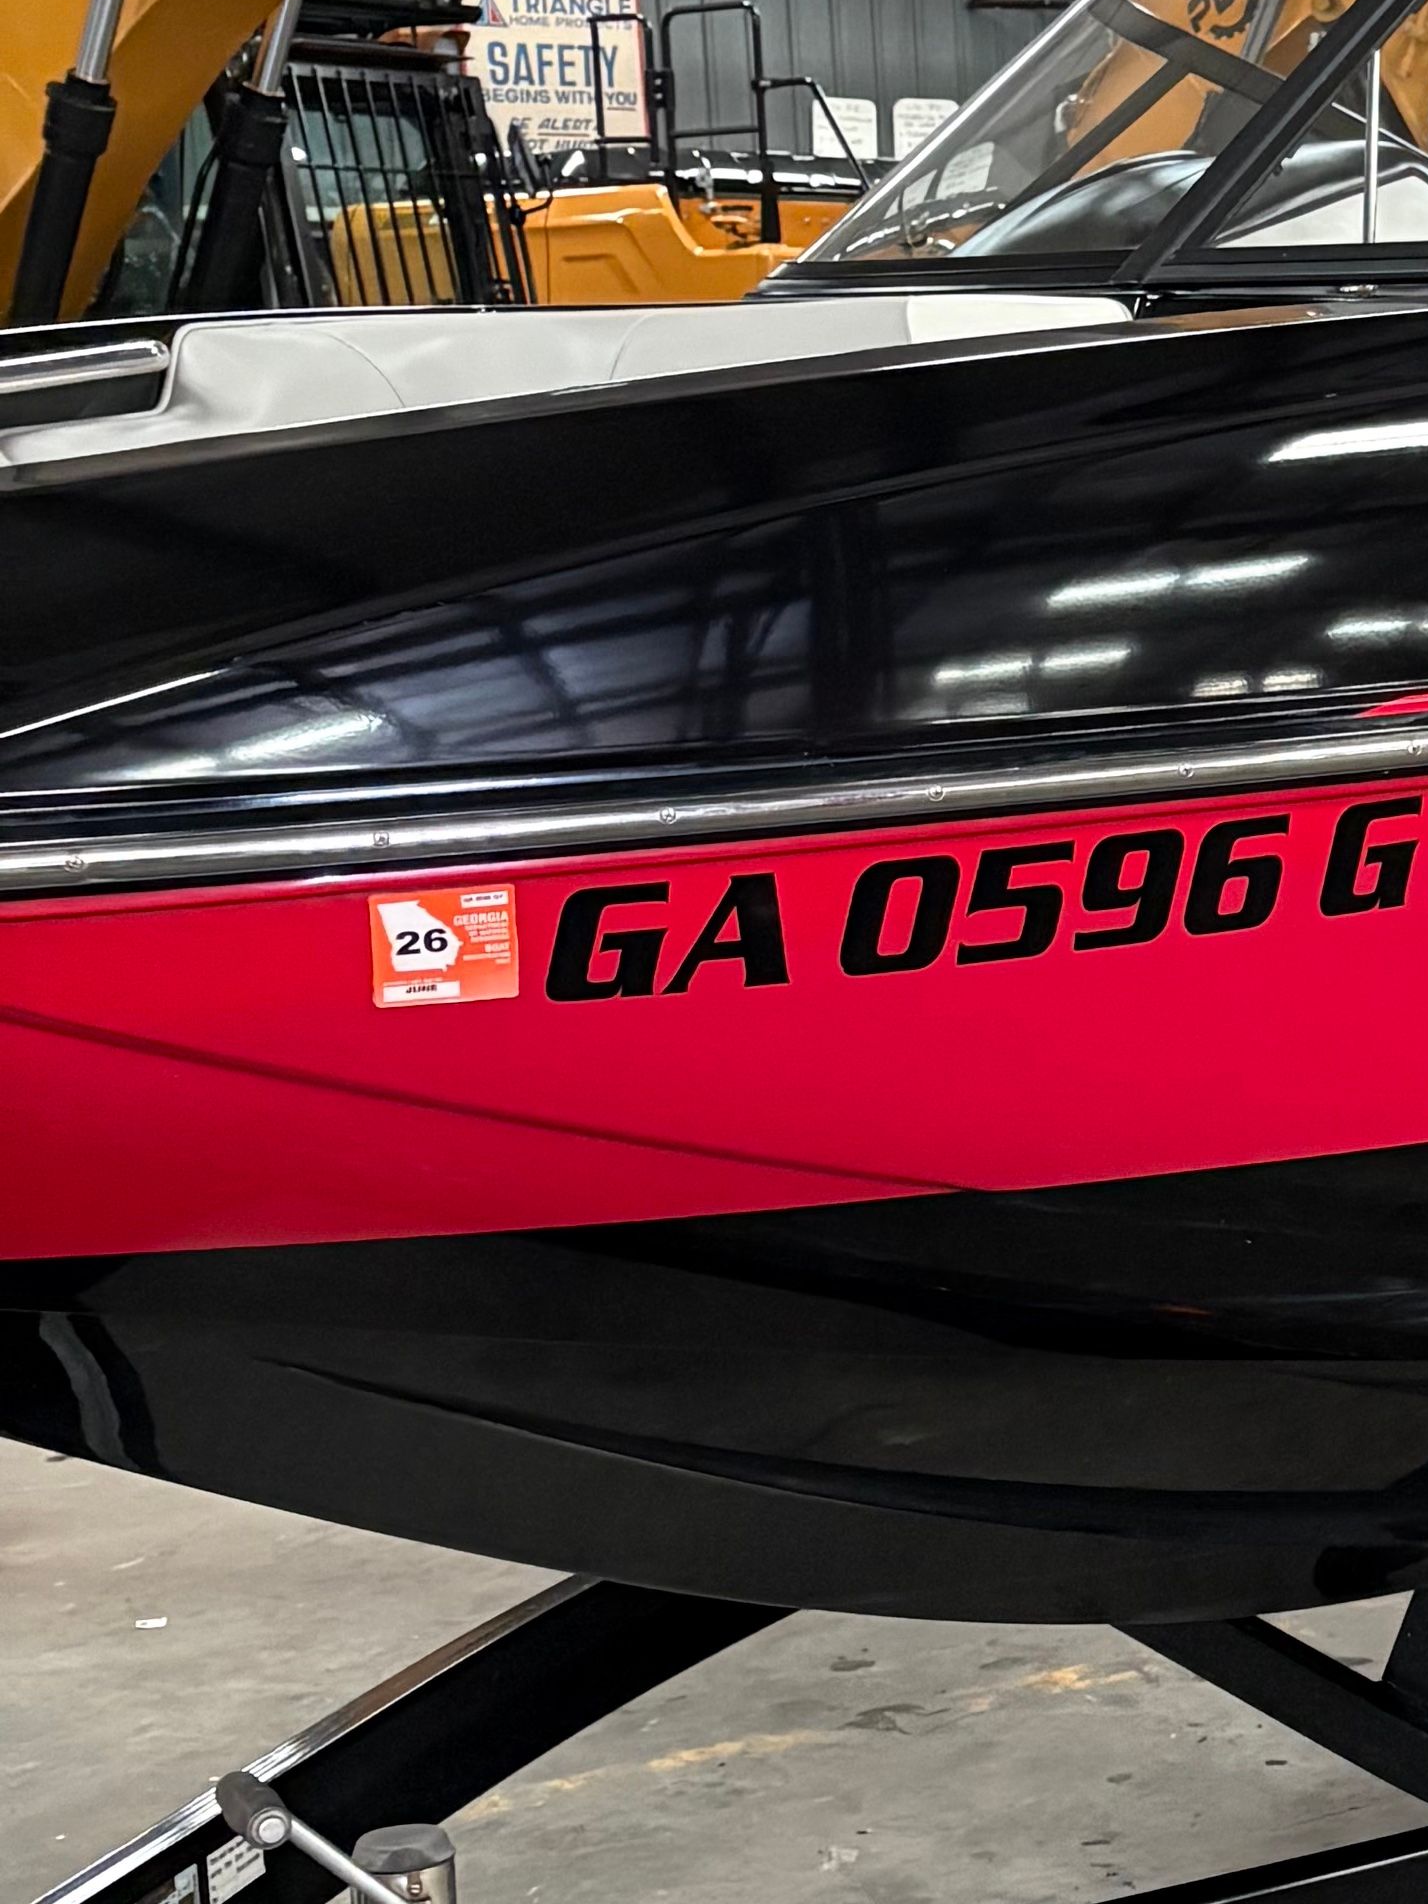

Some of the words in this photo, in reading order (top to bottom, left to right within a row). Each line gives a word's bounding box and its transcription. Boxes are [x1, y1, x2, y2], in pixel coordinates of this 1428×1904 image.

[509, 15, 550, 28] HOME
[486, 41, 618, 89] SAFETY
[607, 91, 638, 106] YOU
[545, 872, 792, 1003] GA
[838, 812, 1292, 978] 0596
[395, 928, 449, 956] 26
